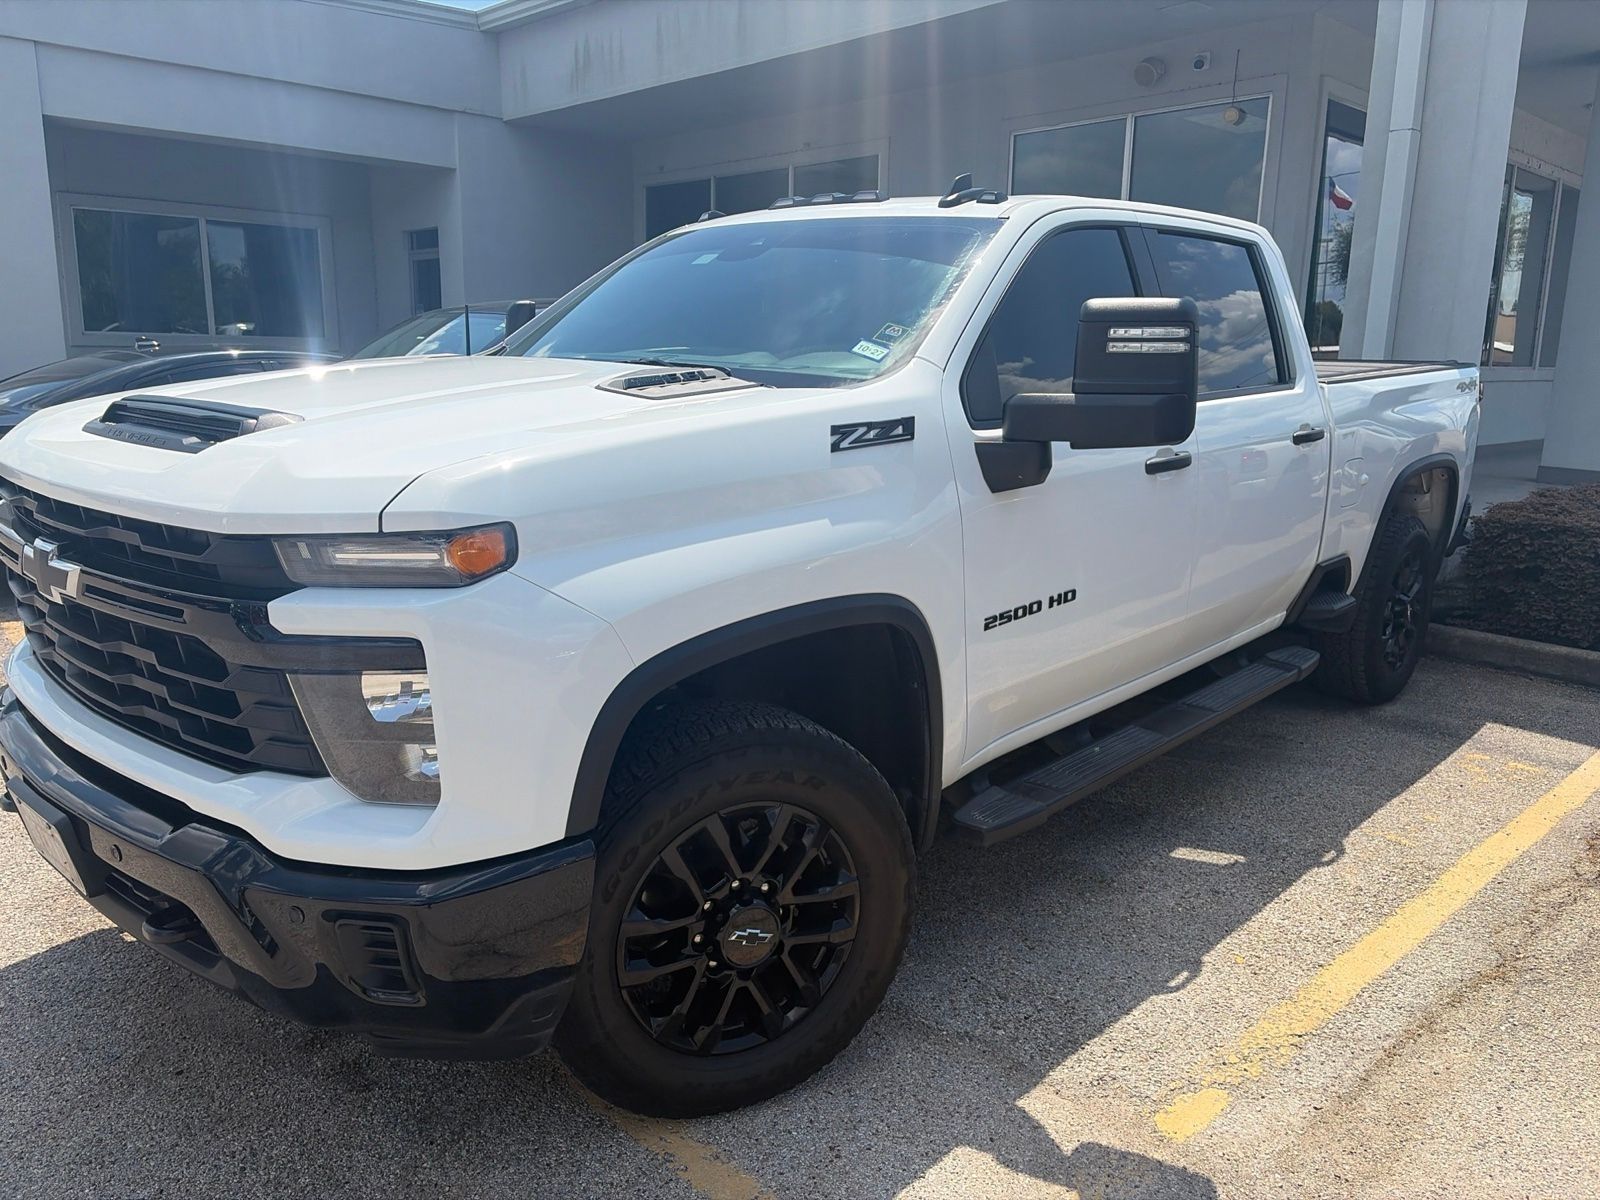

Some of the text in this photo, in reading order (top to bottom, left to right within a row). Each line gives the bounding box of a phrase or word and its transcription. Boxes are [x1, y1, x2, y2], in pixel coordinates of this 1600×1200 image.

[983, 588, 1077, 632] 2500 HD
[606, 769, 827, 898] GOODYEAR
